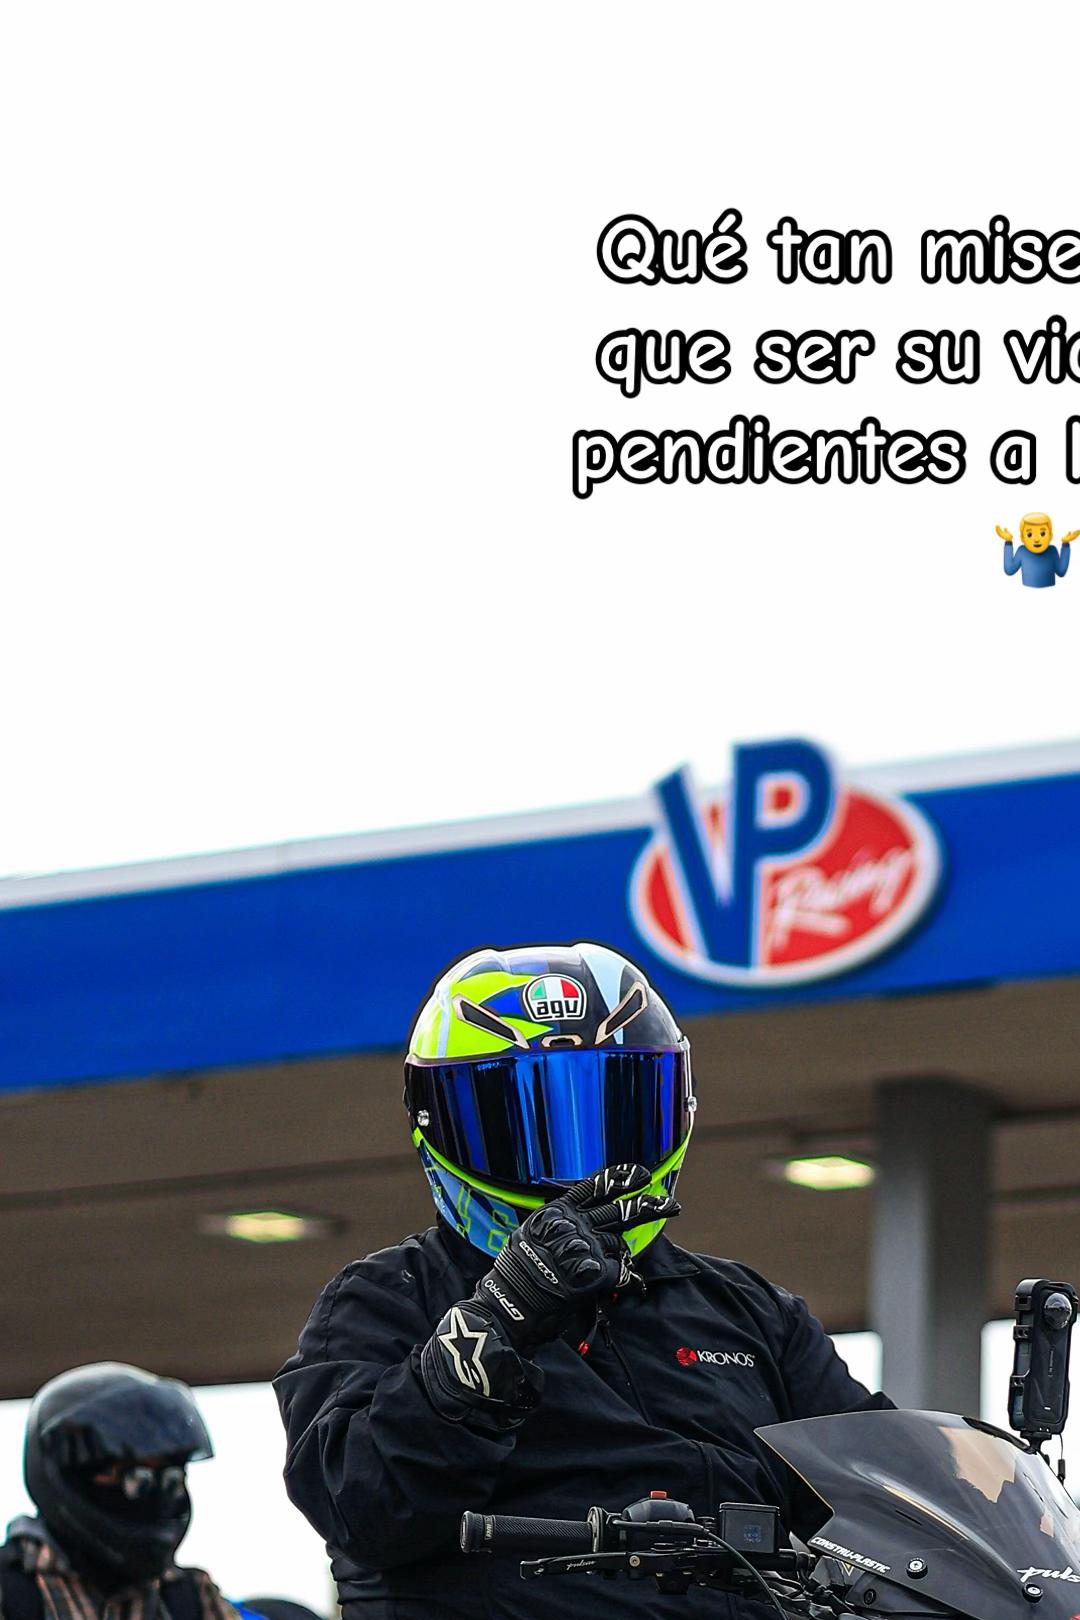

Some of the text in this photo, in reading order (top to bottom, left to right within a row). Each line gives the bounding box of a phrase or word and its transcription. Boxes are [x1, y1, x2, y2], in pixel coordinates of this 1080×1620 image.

[655, 738, 833, 968] VP
[534, 999, 579, 1019] agv
[697, 1350, 754, 1368] KRONOS
